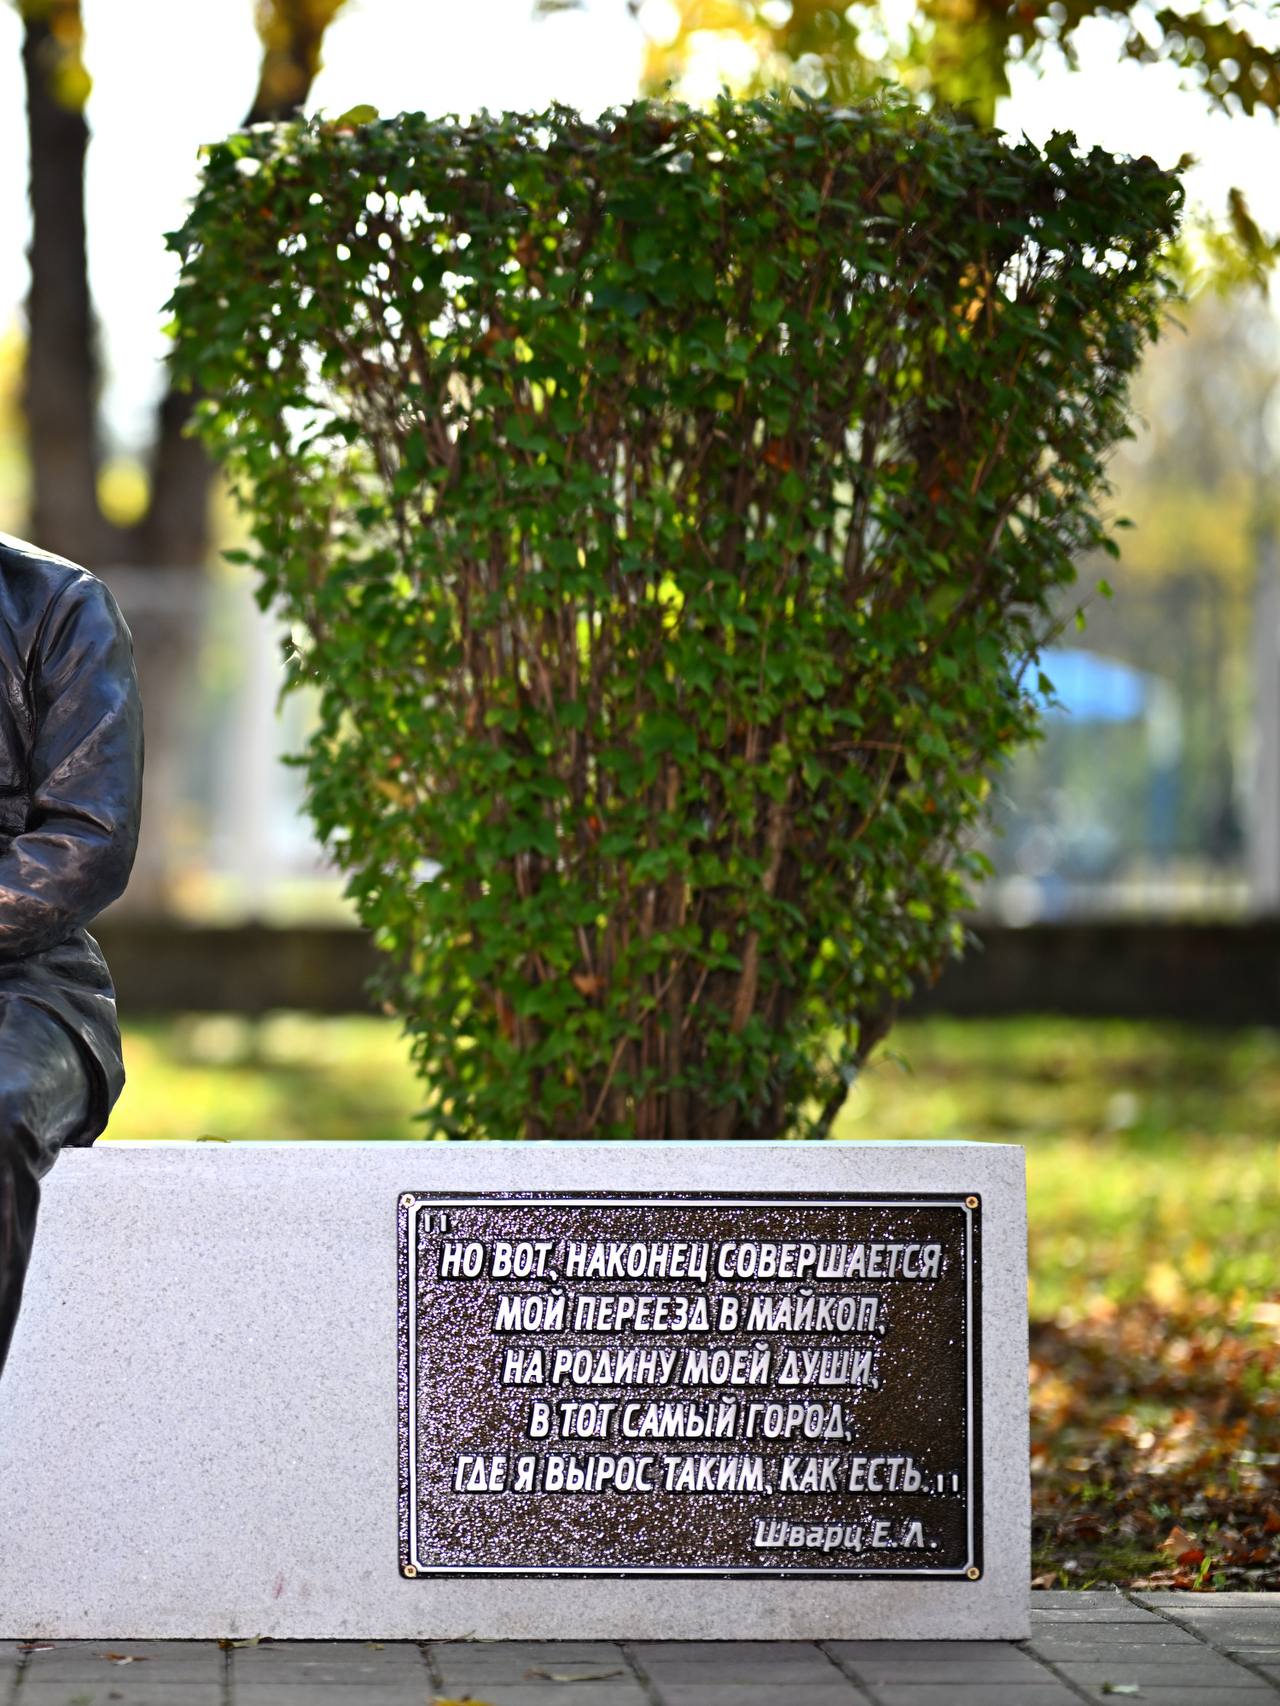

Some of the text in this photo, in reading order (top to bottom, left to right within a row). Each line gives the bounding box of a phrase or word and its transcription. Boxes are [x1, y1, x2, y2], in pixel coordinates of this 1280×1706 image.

[492, 1242, 559, 1282] ВОТ,
[566, 1242, 709, 1283] НАКОНЕЦ
[717, 1243, 942, 1279] СОВЕРШАЕТСЯ
[495, 1287, 887, 1335] МОЙ ПЕРЕЕЗД В МАЙКОП,
[502, 1342, 880, 1389] НА РОДИНУ МОЕЙ ДУШИ,
[529, 1395, 853, 1442] В ТОТ САМЫЙ ГОРОД,
[454, 1455, 507, 1492] ГДЕ
[513, 1455, 537, 1492] Я
[544, 1456, 655, 1492] ВЫРОС
[664, 1456, 773, 1495] ТАКИМ,
[779, 1457, 841, 1493] КАК
[754, 1520, 864, 1552] Шварц
